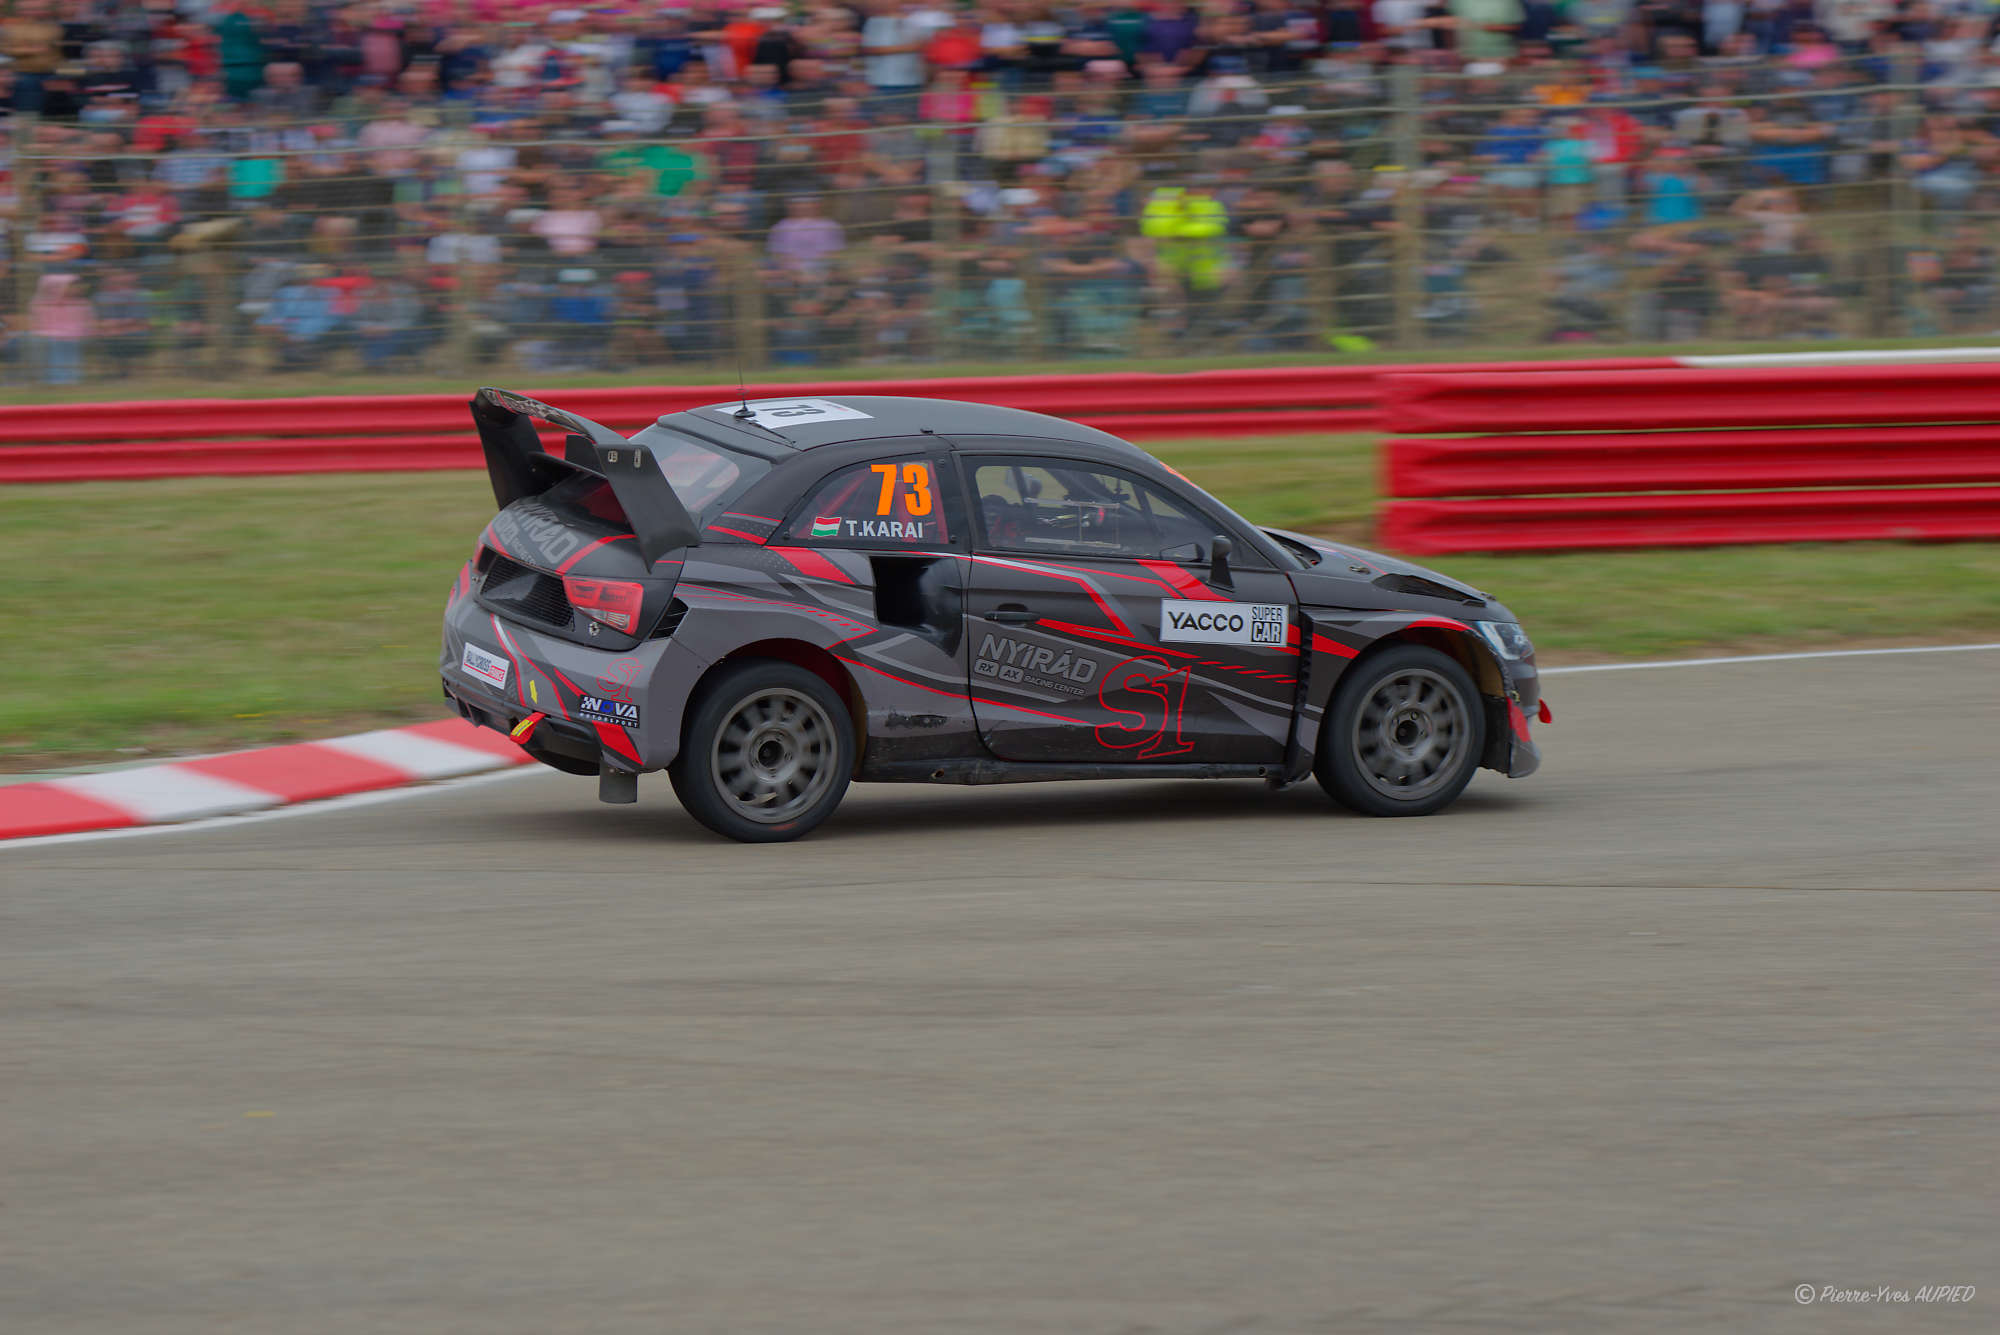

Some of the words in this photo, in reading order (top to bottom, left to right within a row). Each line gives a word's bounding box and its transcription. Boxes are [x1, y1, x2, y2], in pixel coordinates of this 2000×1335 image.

[870, 463, 932, 516] 73
[845, 519, 923, 538] T.KARAI
[1167, 611, 1244, 632] YACCO
[1251, 606, 1283, 621] SUPER
[1252, 622, 1281, 642] CAR
[582, 696, 638, 719] NOVA
[1095, 654, 1195, 761] S1
[580, 712, 638, 728] MOTORSPORT
